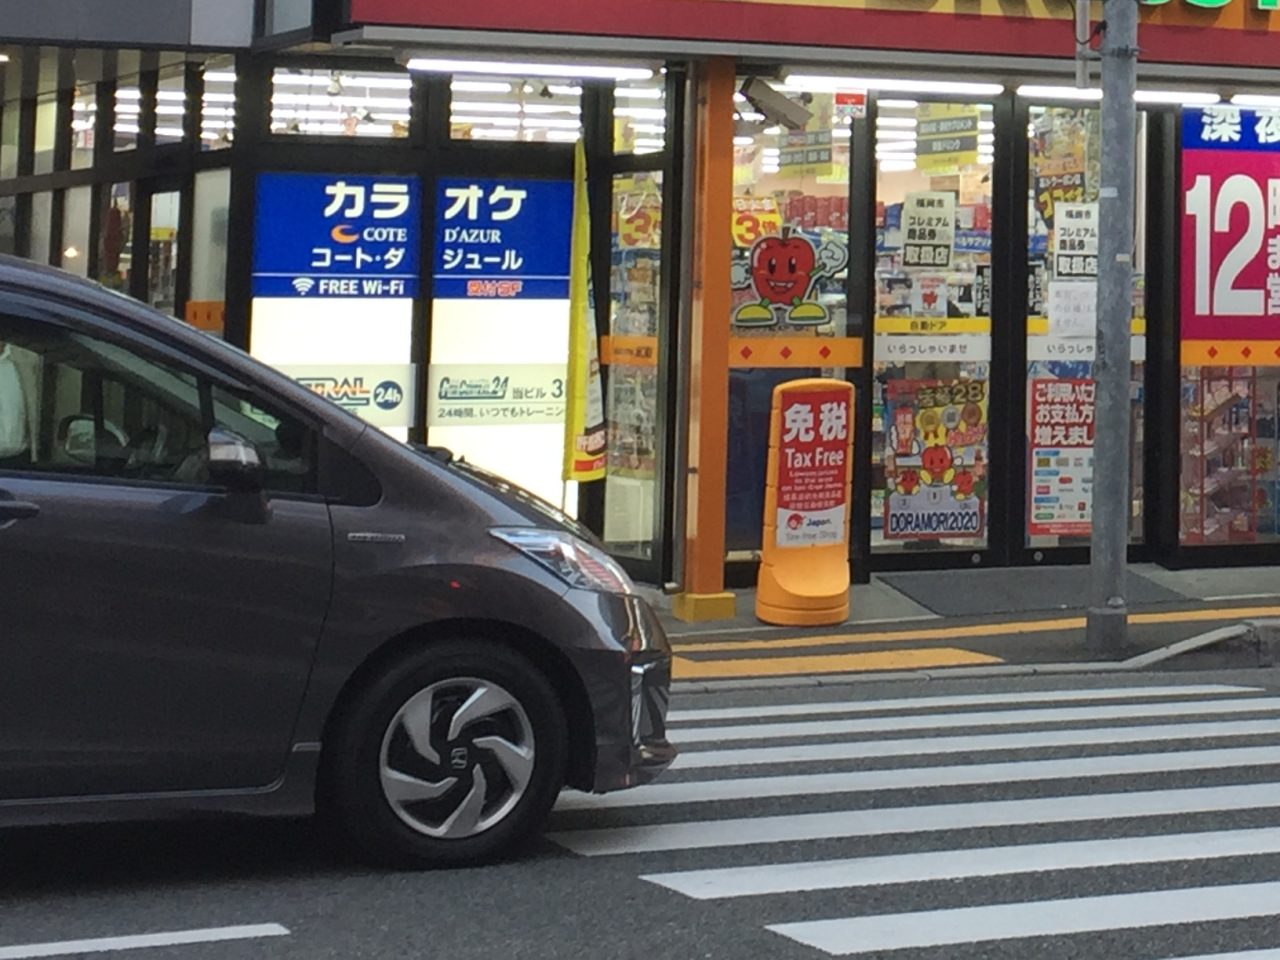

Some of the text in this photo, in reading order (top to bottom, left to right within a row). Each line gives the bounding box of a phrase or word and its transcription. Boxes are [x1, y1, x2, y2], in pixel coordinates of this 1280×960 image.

[909, 216, 949, 228] プレミアム
[363, 227, 407, 242] COTE
[907, 228, 936, 240] 商品券
[1059, 227, 1097, 237] プレミアム
[1059, 240, 1085, 251] 商品券
[1185, 173, 1265, 317] 12
[443, 249, 522, 270] ジュール
[905, 246, 948, 264] 取扱店
[1058, 256, 1097, 275] 取扱店
[319, 280, 404, 294] FREE Wi-Fi
[910, 321, 946, 331] 自動ドア
[887, 343, 967, 355] いらっしゃいませ
[376, 385, 402, 405] 24h
[512, 387, 546, 399] 当ビル
[783, 402, 847, 442] 免税
[785, 447, 844, 468] Tax Free
